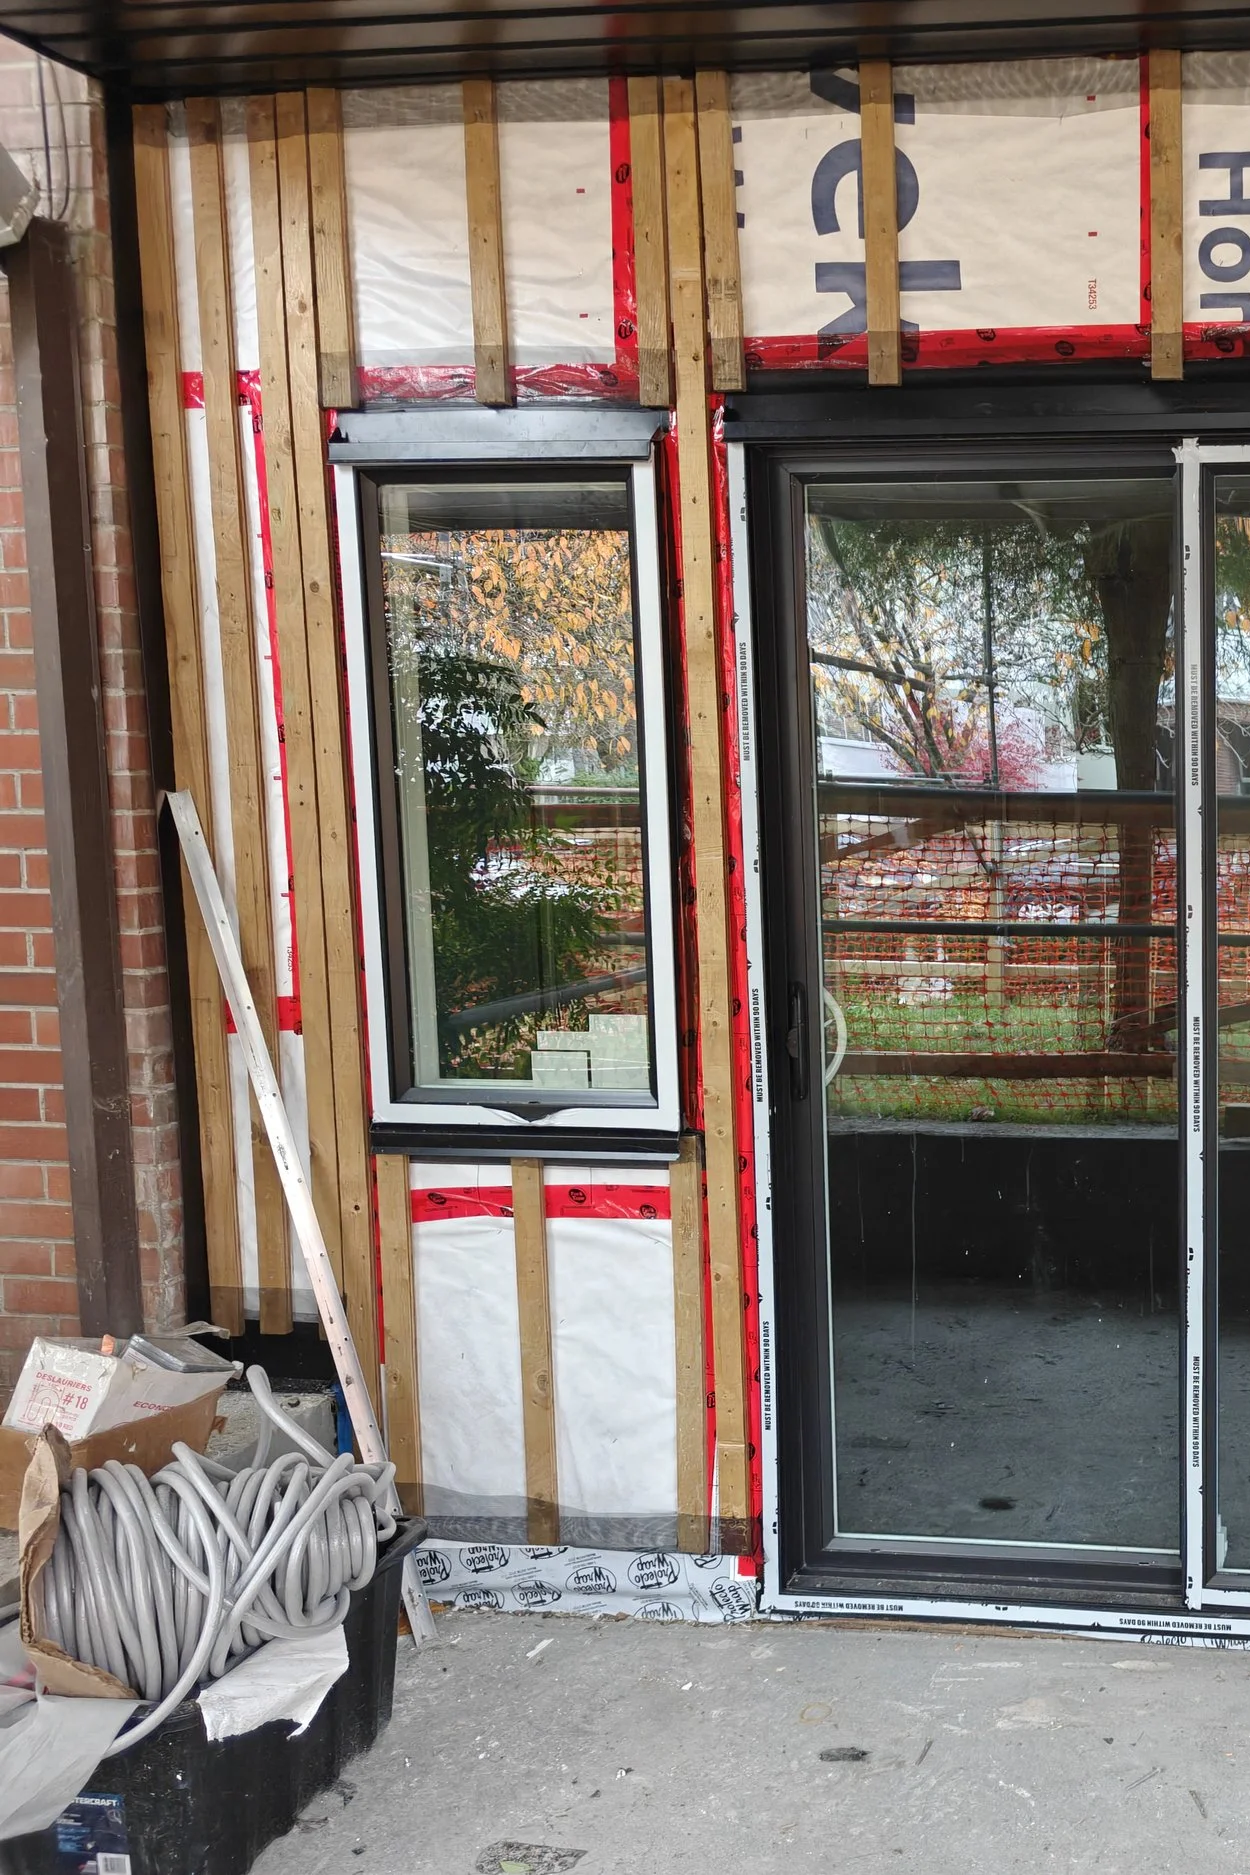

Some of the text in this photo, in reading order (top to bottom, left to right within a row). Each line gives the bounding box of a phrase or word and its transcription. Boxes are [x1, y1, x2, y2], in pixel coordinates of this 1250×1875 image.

[1087, 278, 1097, 310] T34253
[762, 1320, 770, 1338] DAYS
[762, 1338, 770, 1348] 90
[36, 1371, 92, 1392] DESLAURIERS
[763, 1372, 771, 1403] REMOVED
[75, 1395, 89, 1410] 18
[764, 1403, 771, 1412] BE
[1192, 1355, 1200, 1468] MUST BE REMOVED WITHIN 90 DAYS
[764, 1412, 772, 1431] MUST
[466, 1551, 511, 1574] Protecto
[637, 1553, 669, 1572] Wrap
[574, 1566, 606, 1585] Wrap
[634, 1561, 678, 1590] Protecto
[727, 1583, 751, 1615] Wrap
[1119, 1617, 1136, 1626] DAYS
[1171, 1621, 1203, 1630] REMOVED
[1213, 1623, 1232, 1631] MUST
